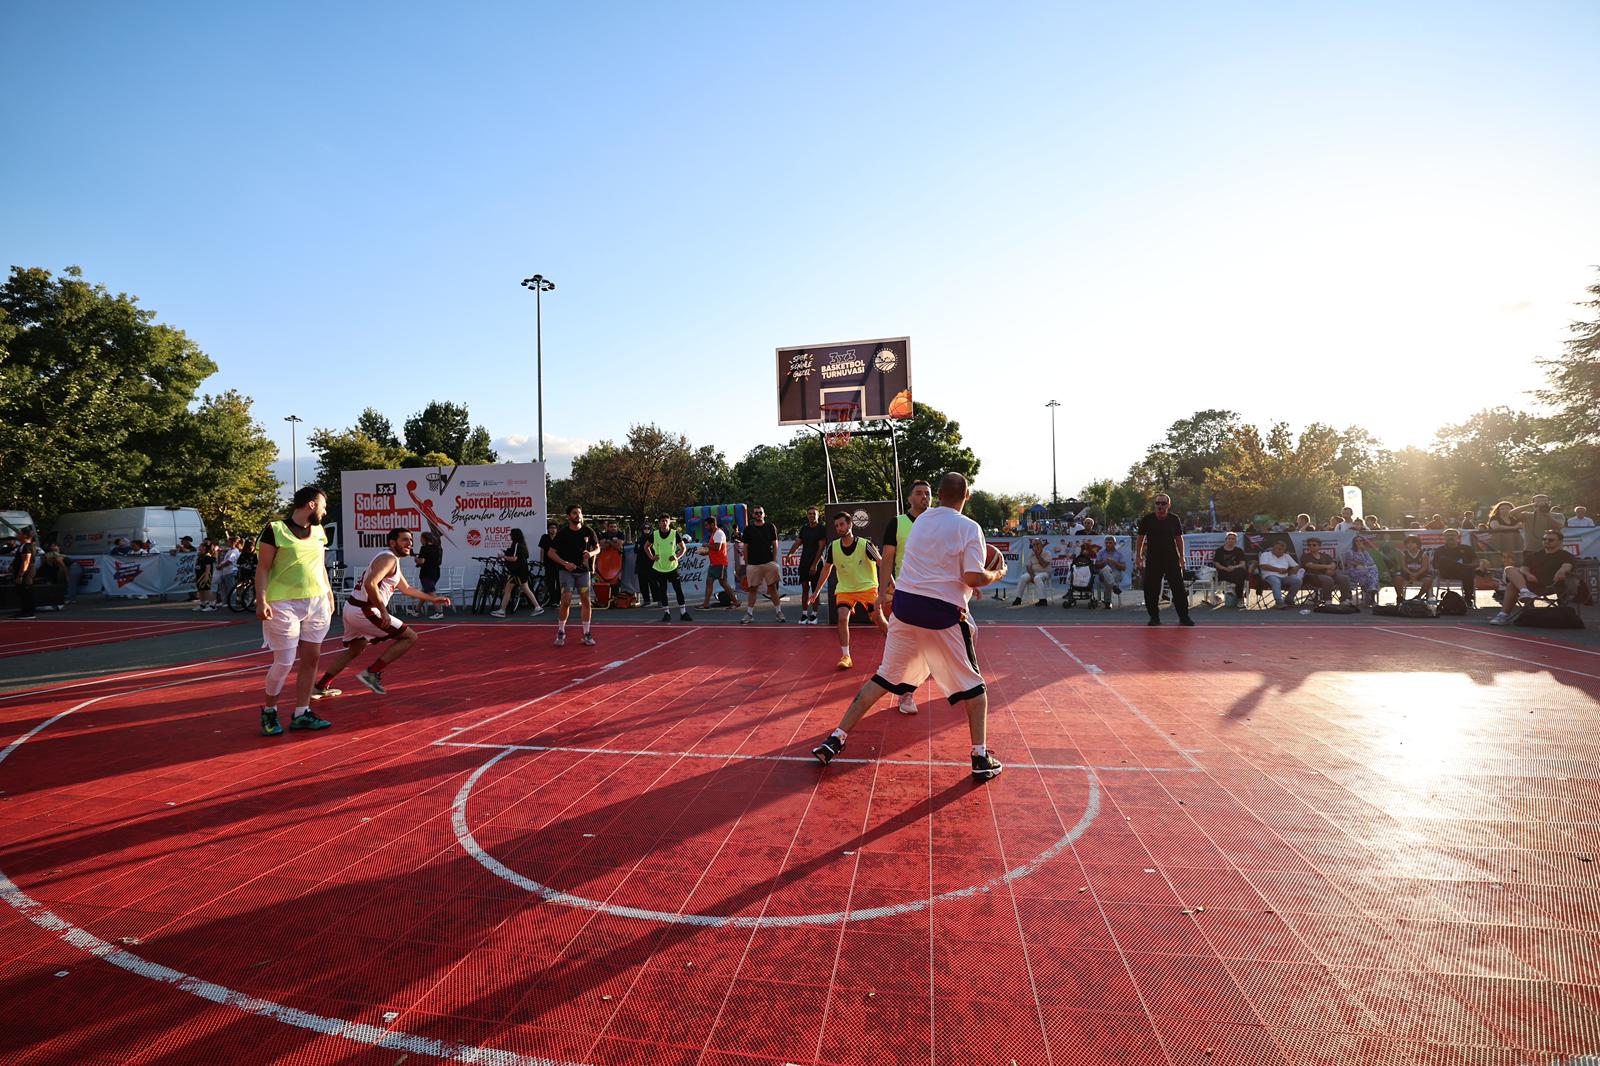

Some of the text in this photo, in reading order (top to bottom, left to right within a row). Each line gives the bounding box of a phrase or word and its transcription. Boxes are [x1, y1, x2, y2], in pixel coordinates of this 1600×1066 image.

[829, 349, 856, 363] 3x3
[821, 360, 865, 373] BASKETBOL
[821, 367, 865, 379] TURNUVASI
[377, 484, 395, 494] 3x3
[356, 494, 390, 510] Sokak
[455, 494, 532, 511] Sporcularımıza
[357, 511, 419, 530] Basketbolu
[484, 526, 511, 534] YUSUF
[357, 531, 389, 548] Turnu
